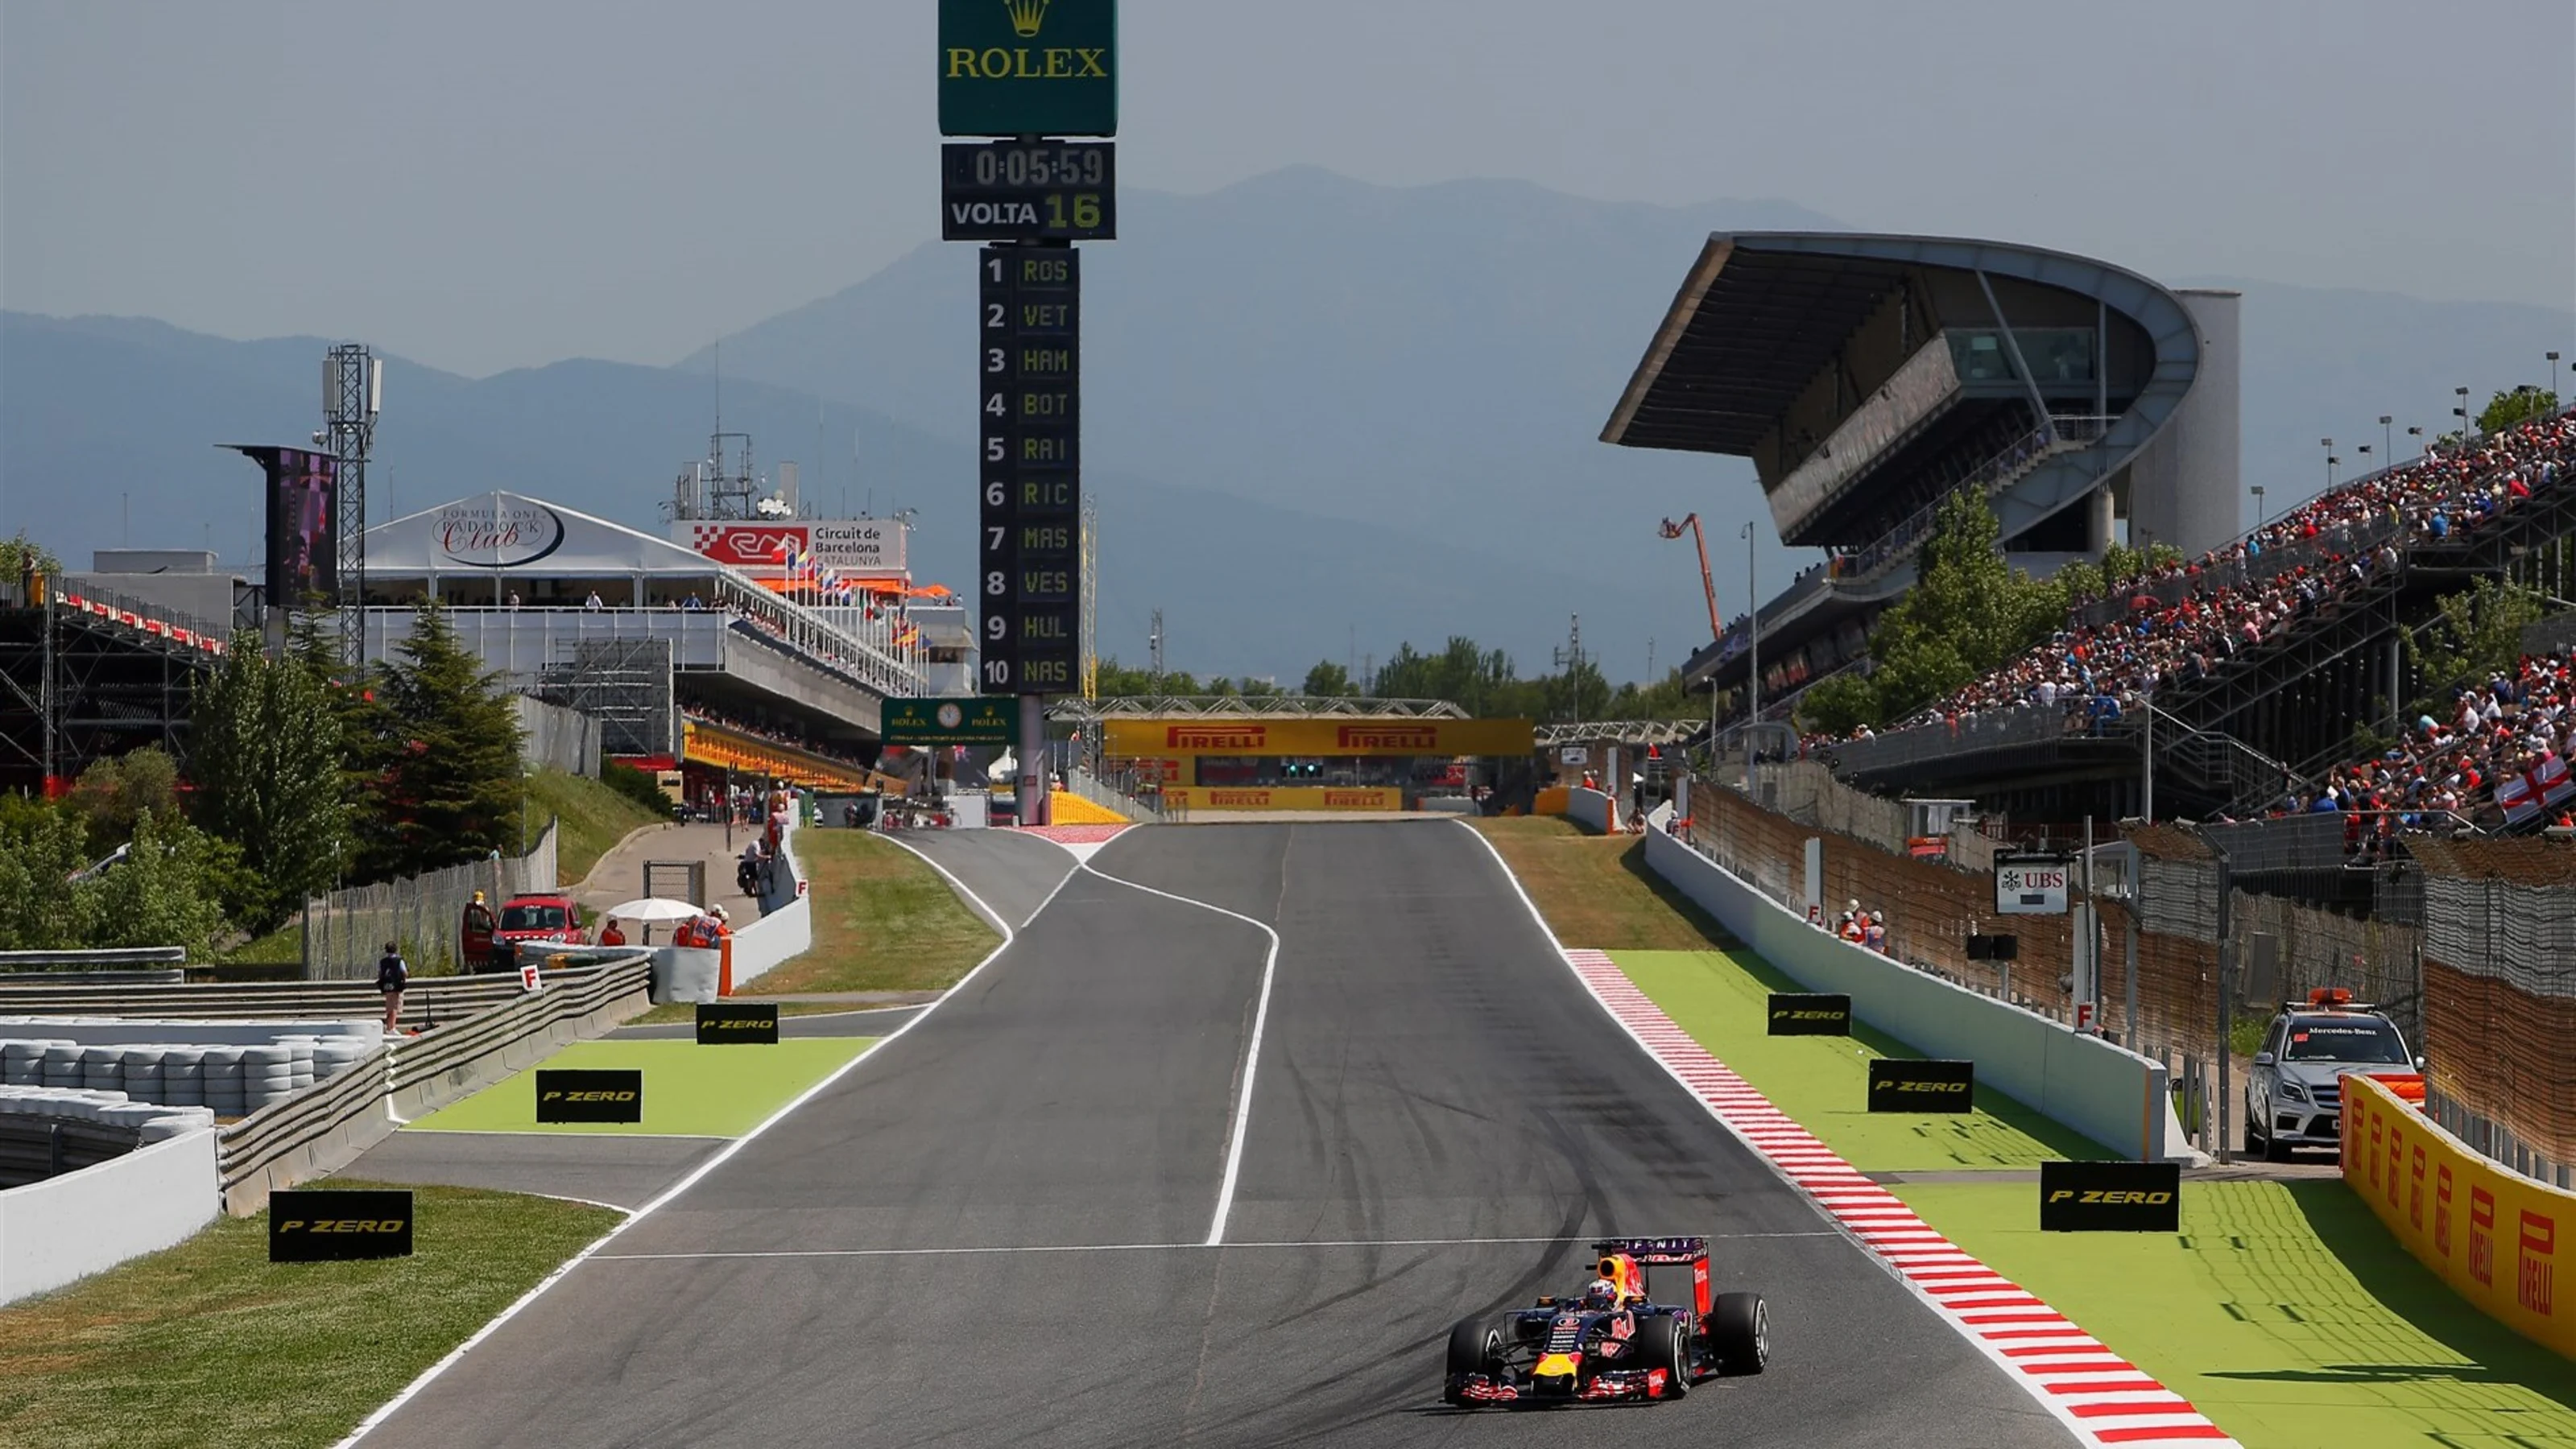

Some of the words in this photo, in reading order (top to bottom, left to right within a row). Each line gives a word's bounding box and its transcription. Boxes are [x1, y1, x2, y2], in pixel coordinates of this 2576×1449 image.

[946, 47, 1108, 78] ROLEX
[976, 150, 1103, 185] 0:05:59
[951, 203, 1038, 225] VOLTA
[1044, 193, 1101, 229] 16
[987, 258, 1002, 282] 1
[1023, 260, 1067, 281] ROS
[987, 303, 1005, 328] 2
[1023, 305, 1067, 326] VET
[987, 349, 1005, 372] 3
[1023, 350, 1068, 371] HAM
[986, 393, 1006, 416] 4
[1023, 394, 1067, 415] BOT
[987, 437, 1005, 461] 5
[1023, 439, 1065, 460] RAI
[986, 482, 1005, 506] 6
[1024, 482, 1068, 505] RIC
[443, 510, 508, 518] FORMULA
[513, 510, 539, 518] ONE
[443, 522, 539, 533] PADDOCK
[444, 520, 519, 554] Club
[816, 526, 862, 539] Circuit
[864, 527, 881, 539] de
[987, 526, 1005, 550] 7
[1024, 528, 1068, 549] MAS
[815, 542, 879, 553] Barcelona
[816, 555, 881, 565] CATALUNYA
[986, 572, 1006, 596] 8
[1024, 572, 1067, 593] VES
[987, 616, 1006, 640] 9
[1024, 617, 1067, 638] HUL
[985, 660, 1008, 683] 10
[1024, 661, 1067, 682] NAS
[1167, 726, 1267, 748] PIRELLI
[1338, 726, 1437, 748] PIRELLI
[1210, 791, 1270, 805] PIRELLI
[1325, 791, 1384, 806] PIRELLI
[799, 881, 807, 894] F
[2024, 873, 2063, 888] UBS
[1809, 905, 1820, 920] F
[524, 968, 536, 989] F
[701, 1020, 716, 1029] P
[718, 1020, 774, 1029] ZERO
[1773, 1010, 1788, 1019] P
[1791, 1010, 1844, 1020] ZERO
[2078, 1005, 2092, 1028] F
[2309, 1027, 2378, 1036] Mercedes-Benz
[543, 1092, 562, 1101] P
[565, 1092, 635, 1101] ZERO
[1875, 1080, 1894, 1091] P
[1897, 1081, 1966, 1092] ZERO
[2049, 1190, 2074, 1203] P
[2079, 1191, 2172, 1204] ZERO
[279, 1220, 304, 1232] P
[309, 1220, 404, 1232] ZERO
[2519, 1208, 2554, 1316] PIRELLI
